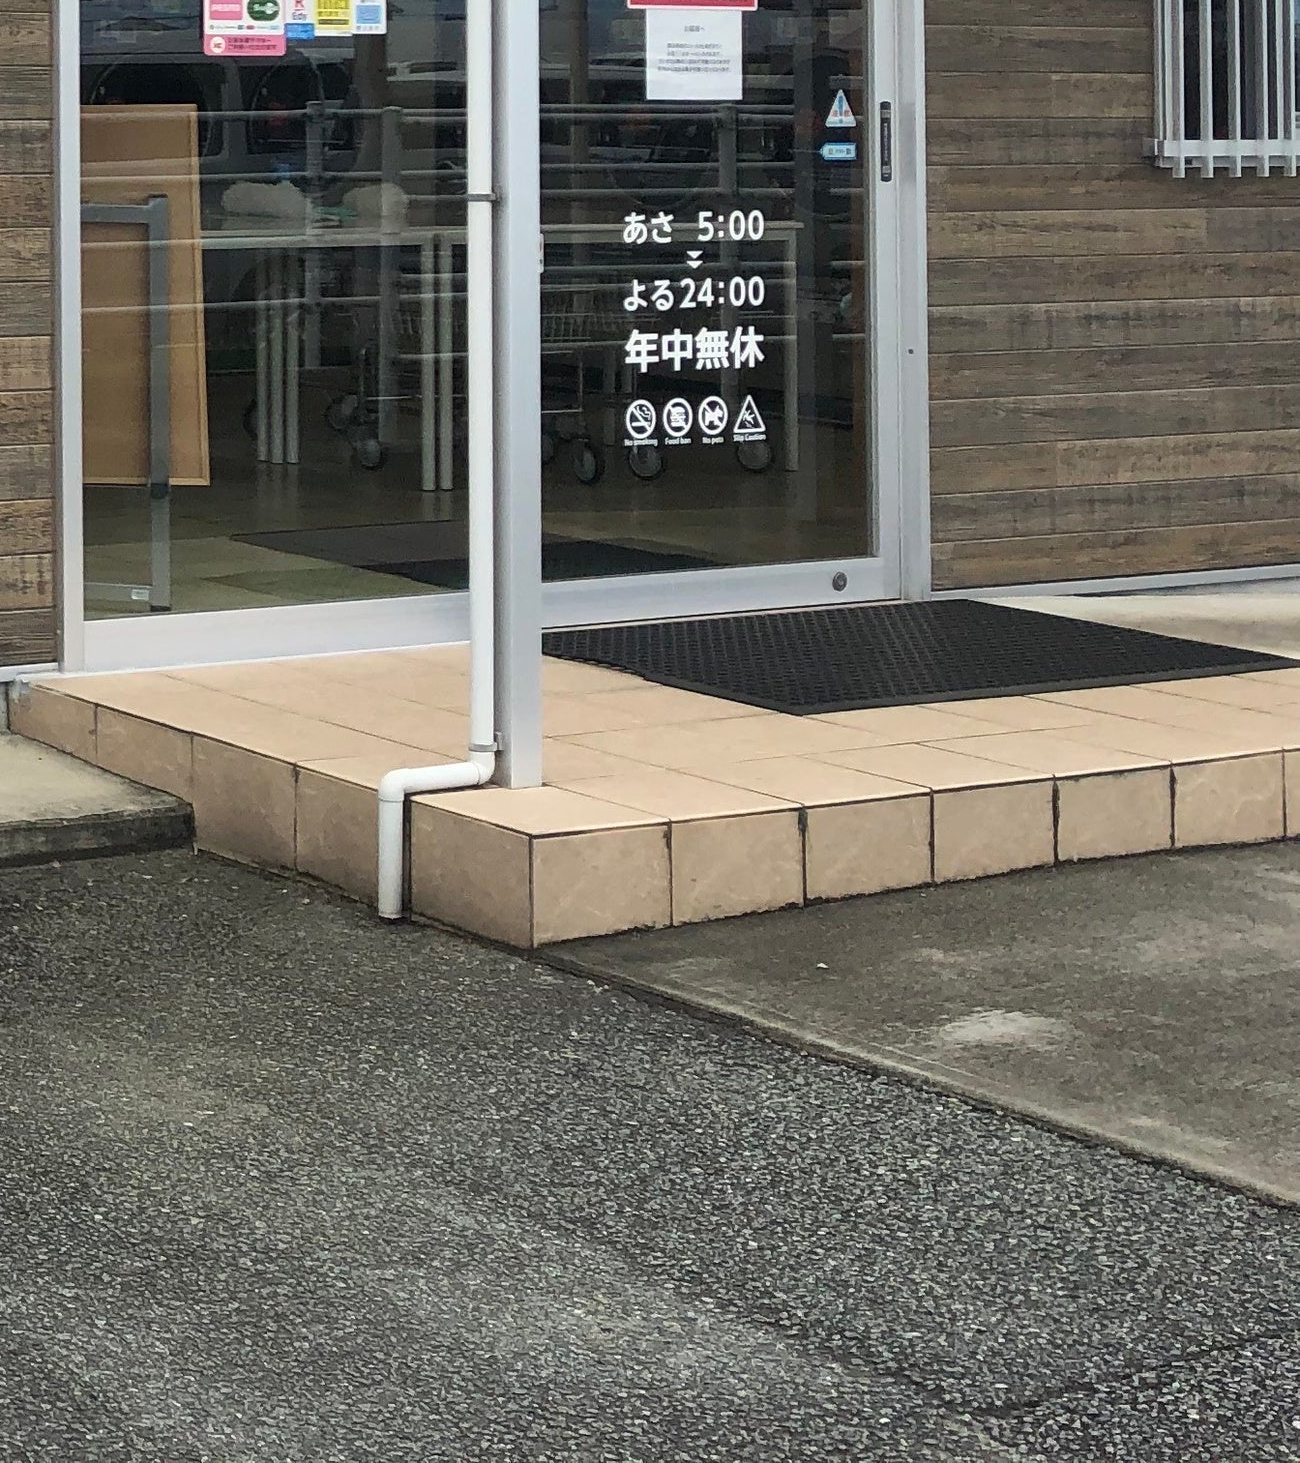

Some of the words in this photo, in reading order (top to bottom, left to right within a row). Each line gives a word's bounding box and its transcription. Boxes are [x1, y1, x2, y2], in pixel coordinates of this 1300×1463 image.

[623, 211, 675, 245] あさ
[697, 209, 765, 242] 5:00
[624, 325, 765, 373] 年中無休
